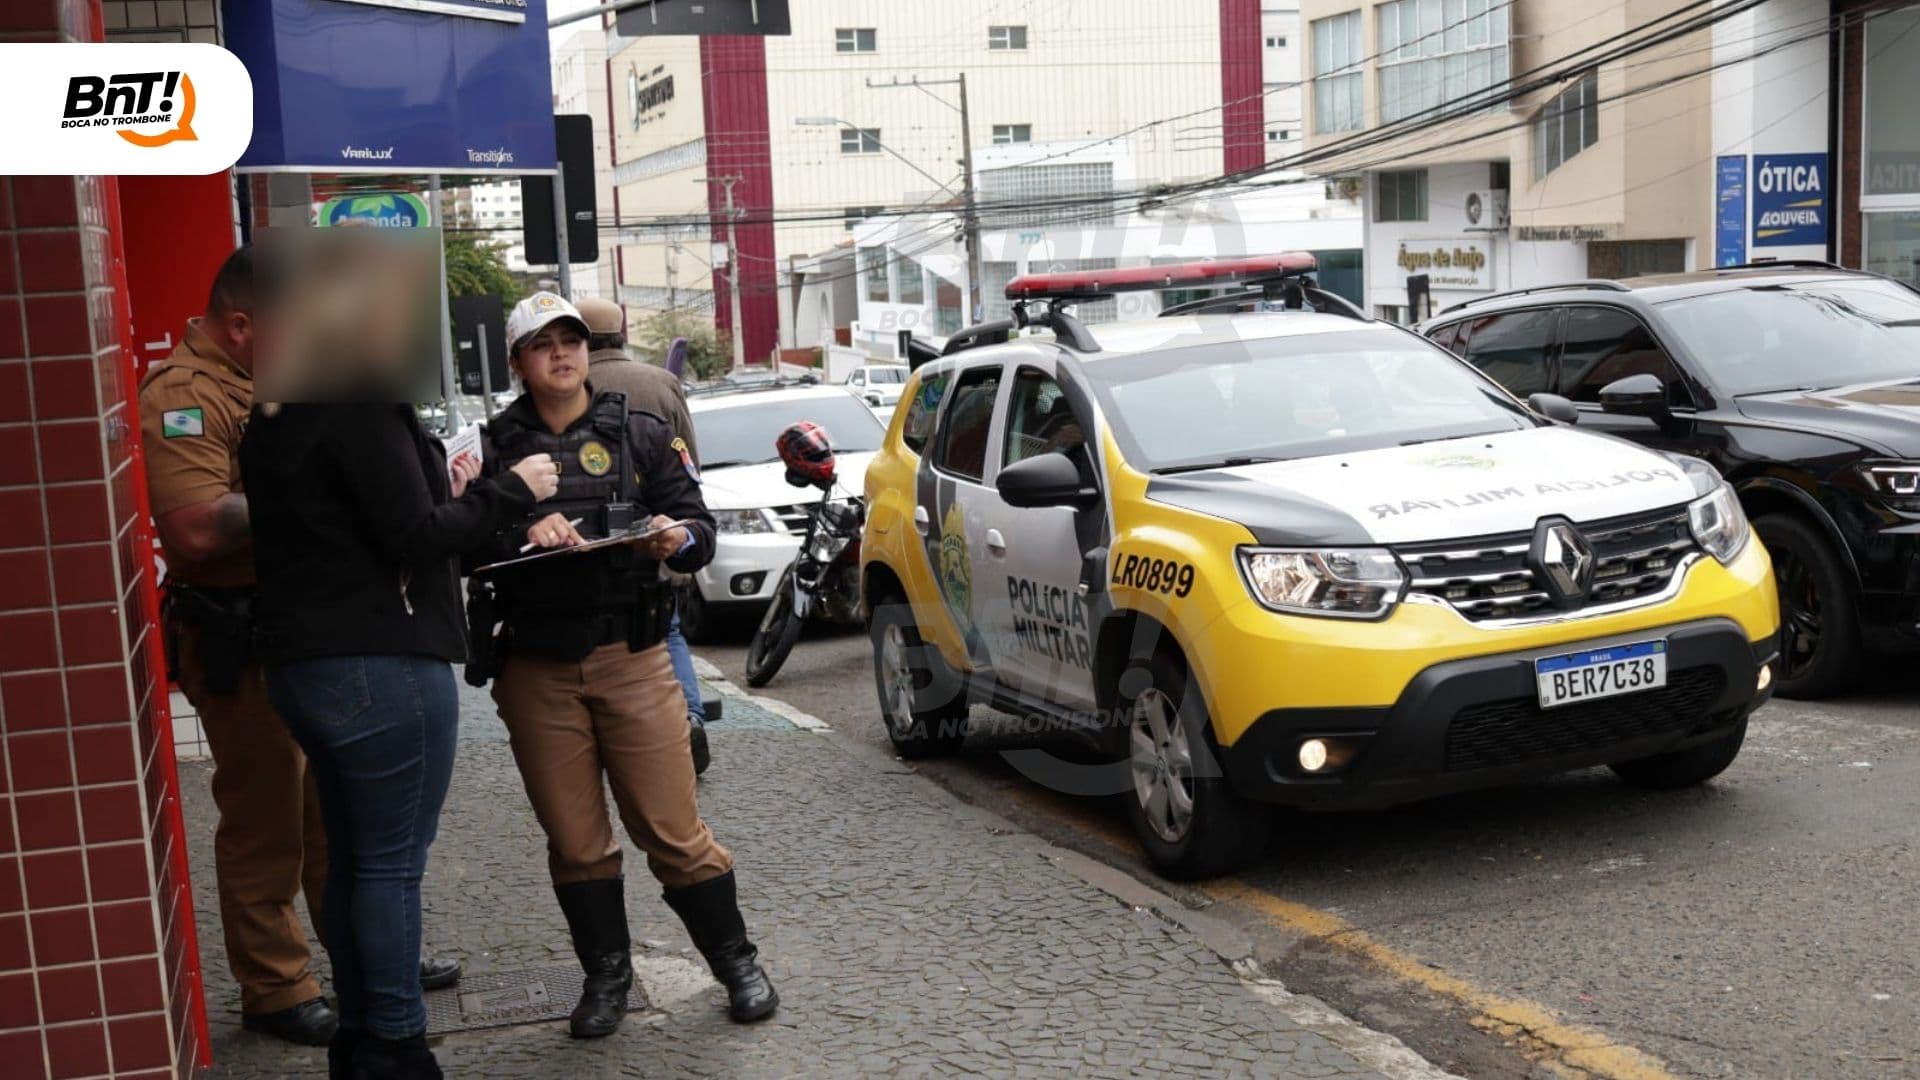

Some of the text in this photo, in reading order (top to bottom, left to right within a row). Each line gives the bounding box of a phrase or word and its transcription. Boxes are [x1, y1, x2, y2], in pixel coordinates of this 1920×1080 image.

[341, 146, 394, 160] VARILUX
[466, 147, 514, 168] Transitions
[1758, 161, 1821, 193] ÓTICA
[1758, 210, 1821, 227] GOUVEIA
[1398, 243, 1431, 272] Água
[1432, 248, 1450, 268] de
[1111, 553, 1194, 598] LR0899
[1012, 613, 1093, 673] MILITAR
[1553, 658, 1655, 701] BER7C38
